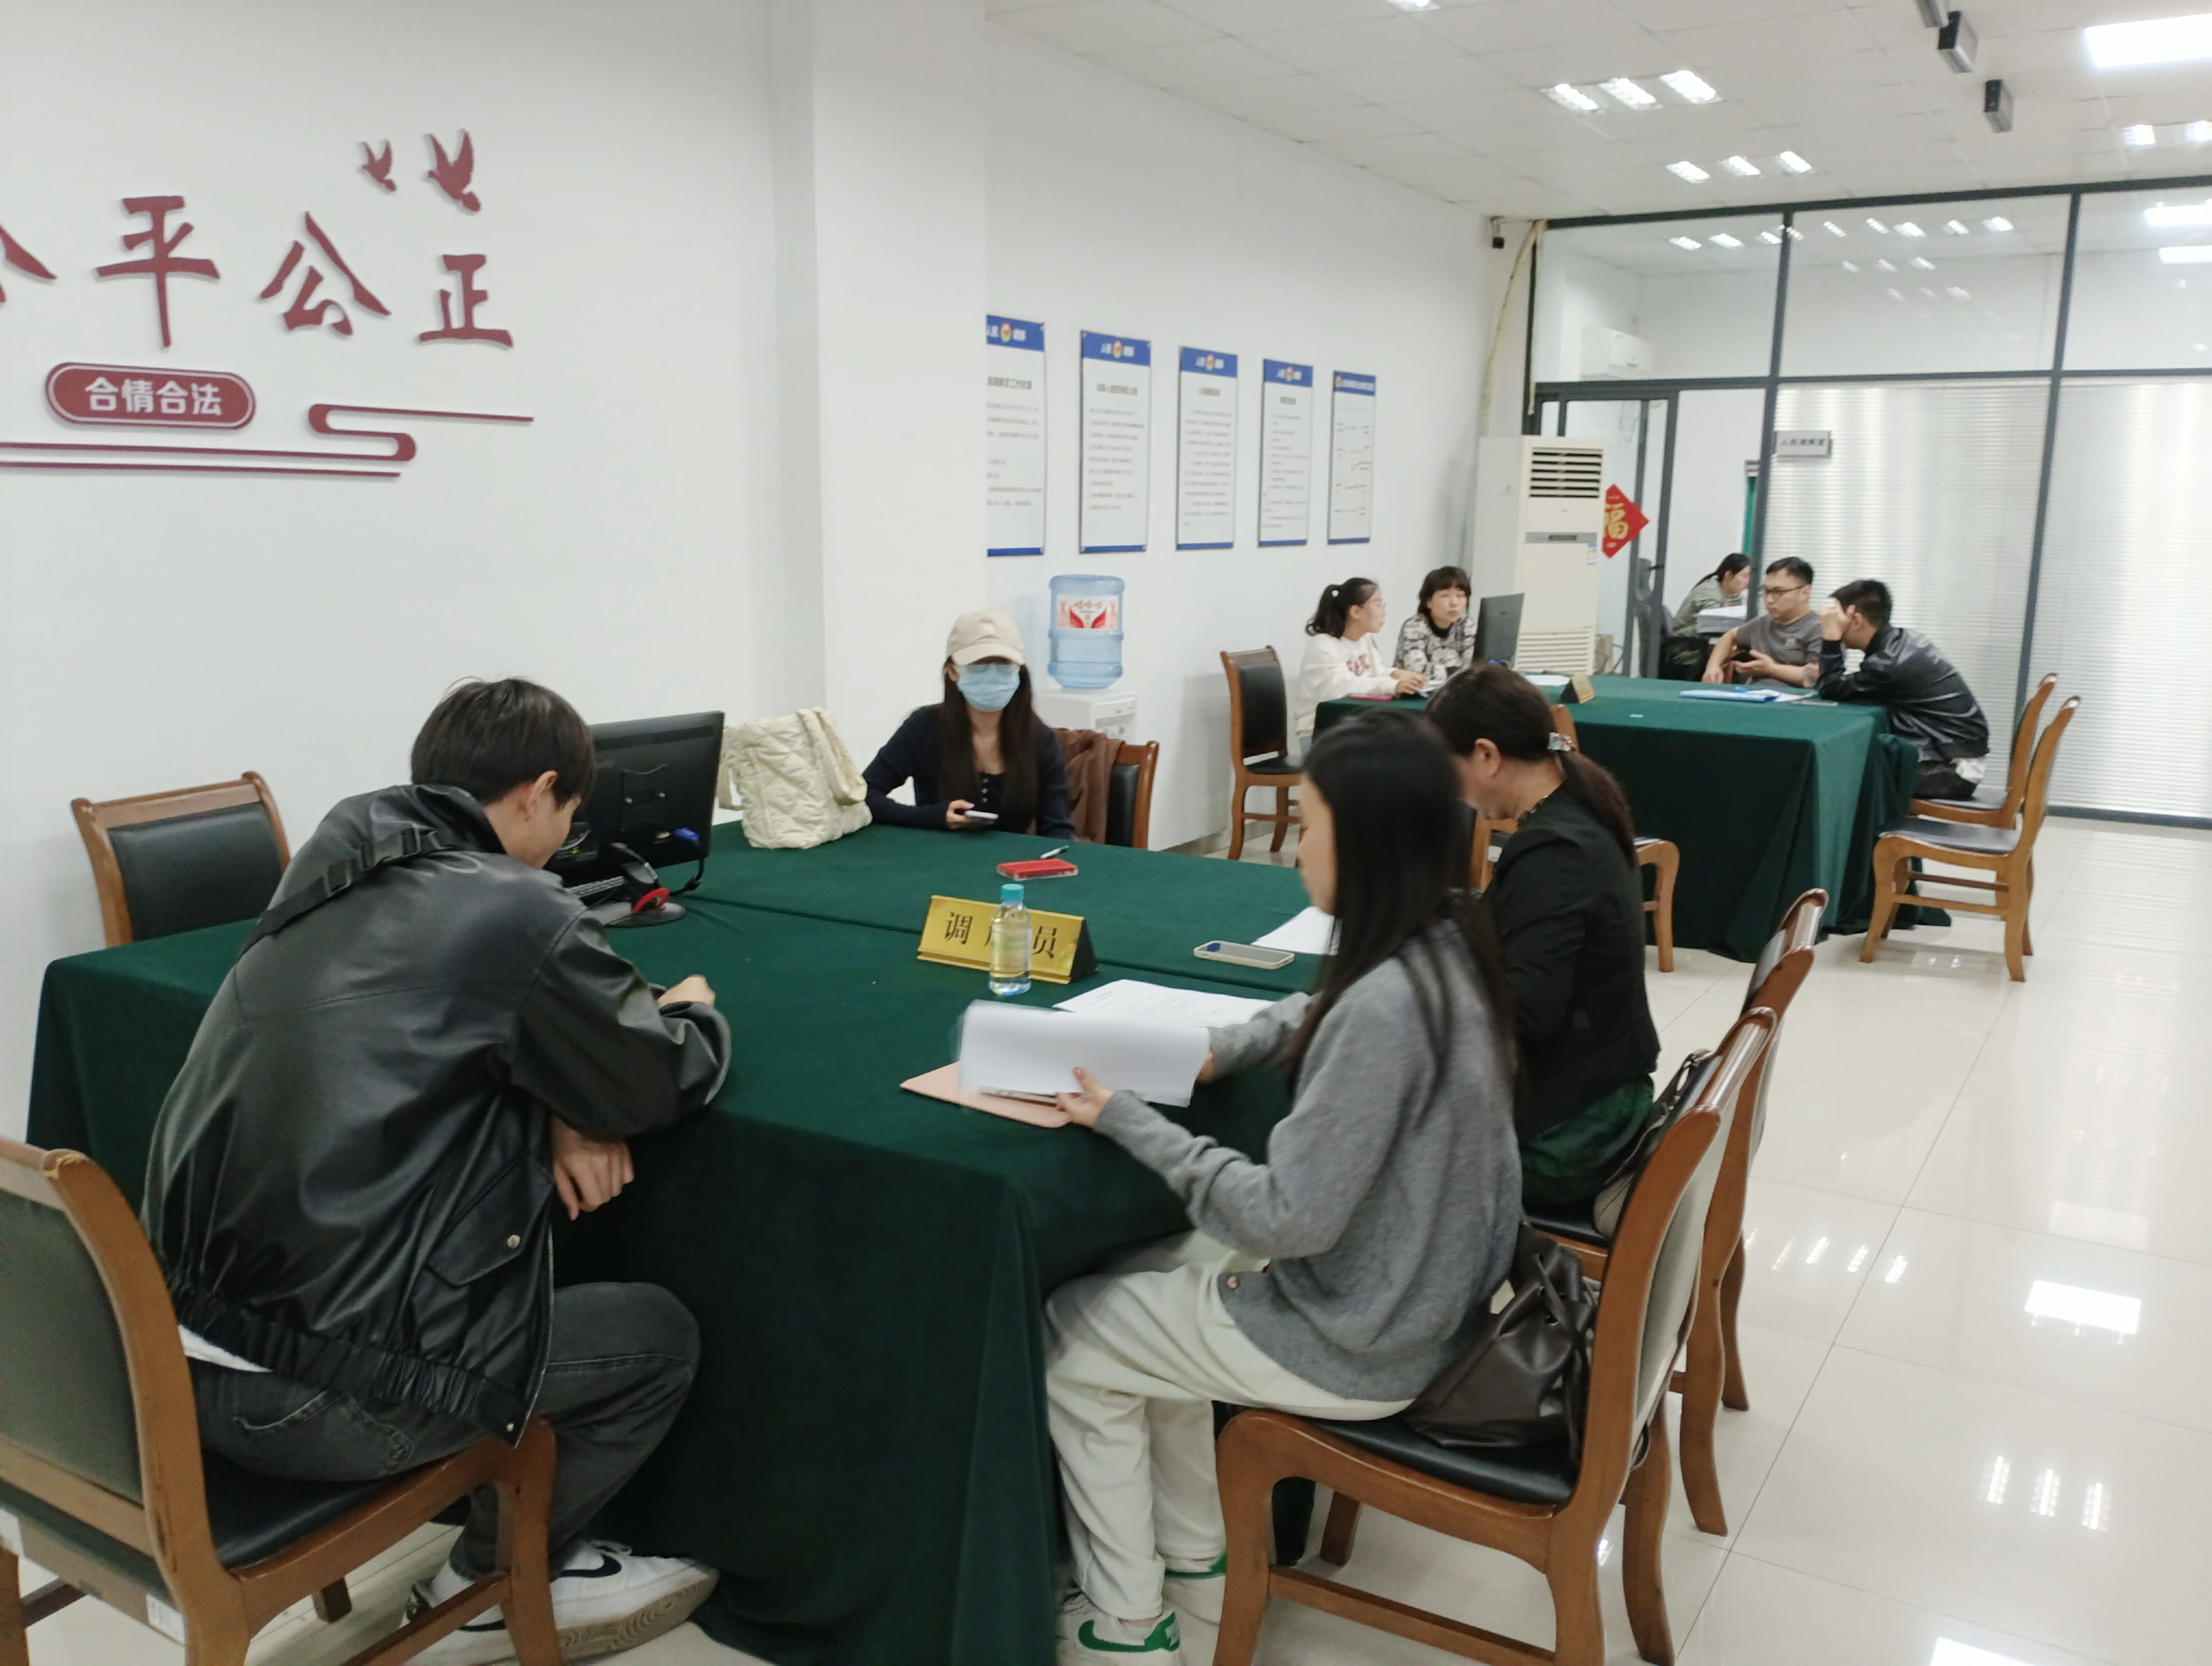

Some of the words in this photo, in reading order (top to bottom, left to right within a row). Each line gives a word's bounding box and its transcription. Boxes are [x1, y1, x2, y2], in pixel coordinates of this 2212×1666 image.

[85, 376, 222, 416] 合情合法
[943, 911, 1057, 959] 调员
